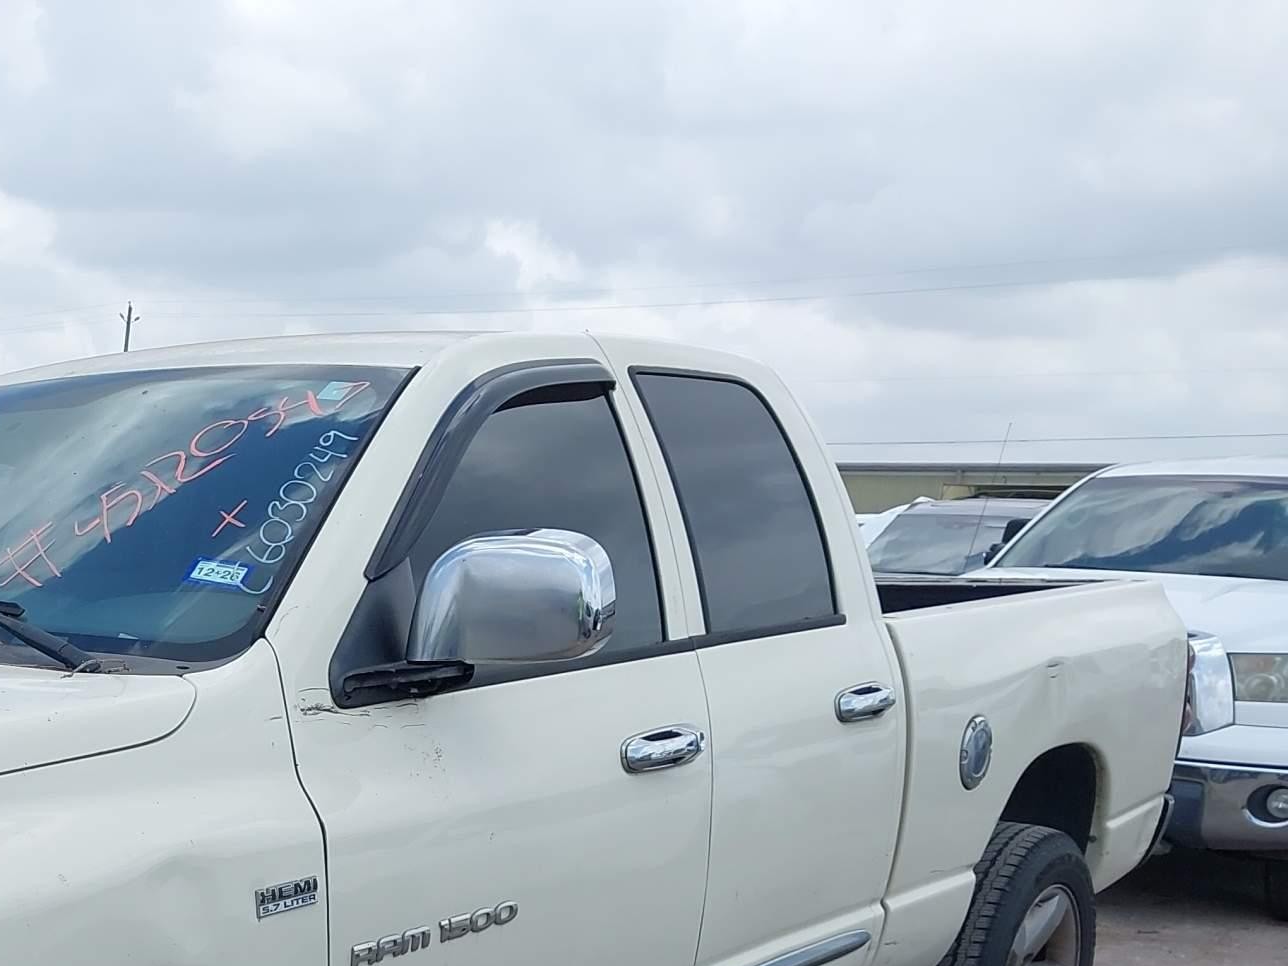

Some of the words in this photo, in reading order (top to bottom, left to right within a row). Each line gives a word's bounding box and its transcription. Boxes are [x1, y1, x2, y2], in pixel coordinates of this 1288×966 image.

[259, 877, 319, 904] HEMI
[262, 902, 281, 915] 5.7
[283, 893, 316, 909] LITER
[439, 899, 519, 943] 1500
